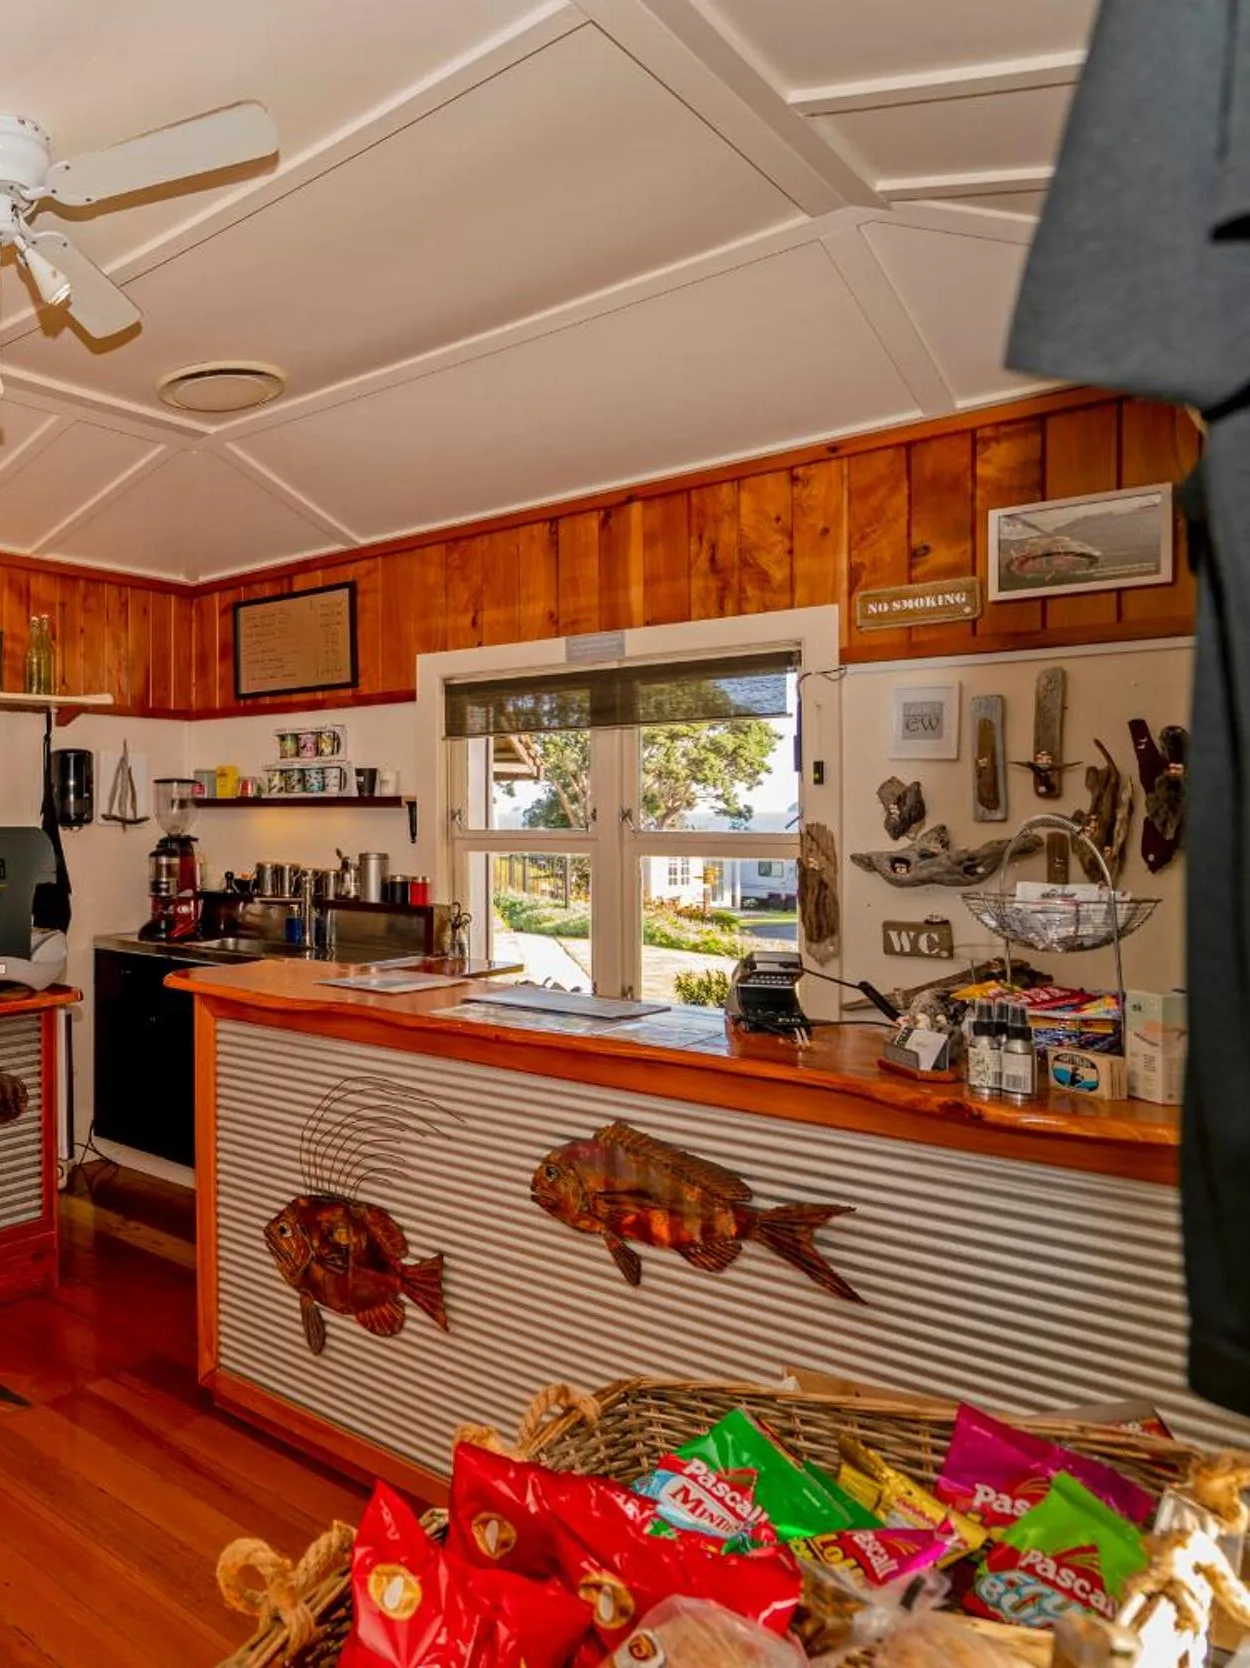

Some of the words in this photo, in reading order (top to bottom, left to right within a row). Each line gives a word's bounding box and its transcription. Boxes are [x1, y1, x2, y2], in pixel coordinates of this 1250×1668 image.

[867, 601, 890, 615] NO
[892, 591, 967, 612] SMOKING
[682, 1457, 770, 1523] Pascall
